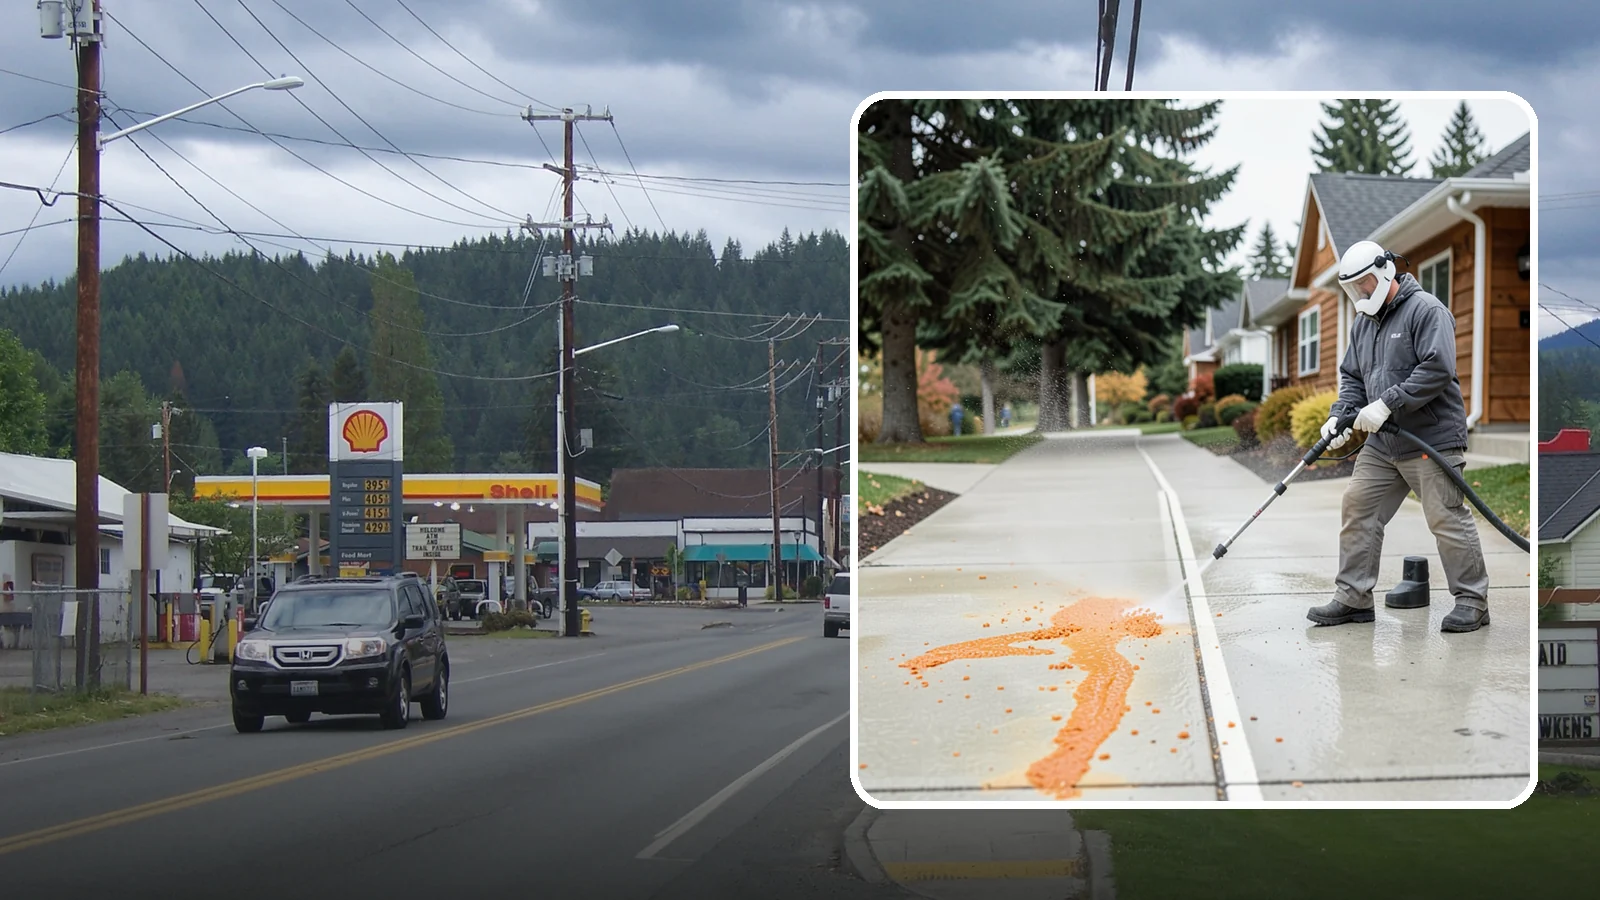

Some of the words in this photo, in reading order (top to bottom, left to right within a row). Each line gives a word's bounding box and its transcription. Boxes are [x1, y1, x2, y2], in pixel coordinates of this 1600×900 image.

[490, 484, 547, 499] Shell
[1539, 643, 1566, 665] AID
[1539, 717, 1592, 738] WKENS
